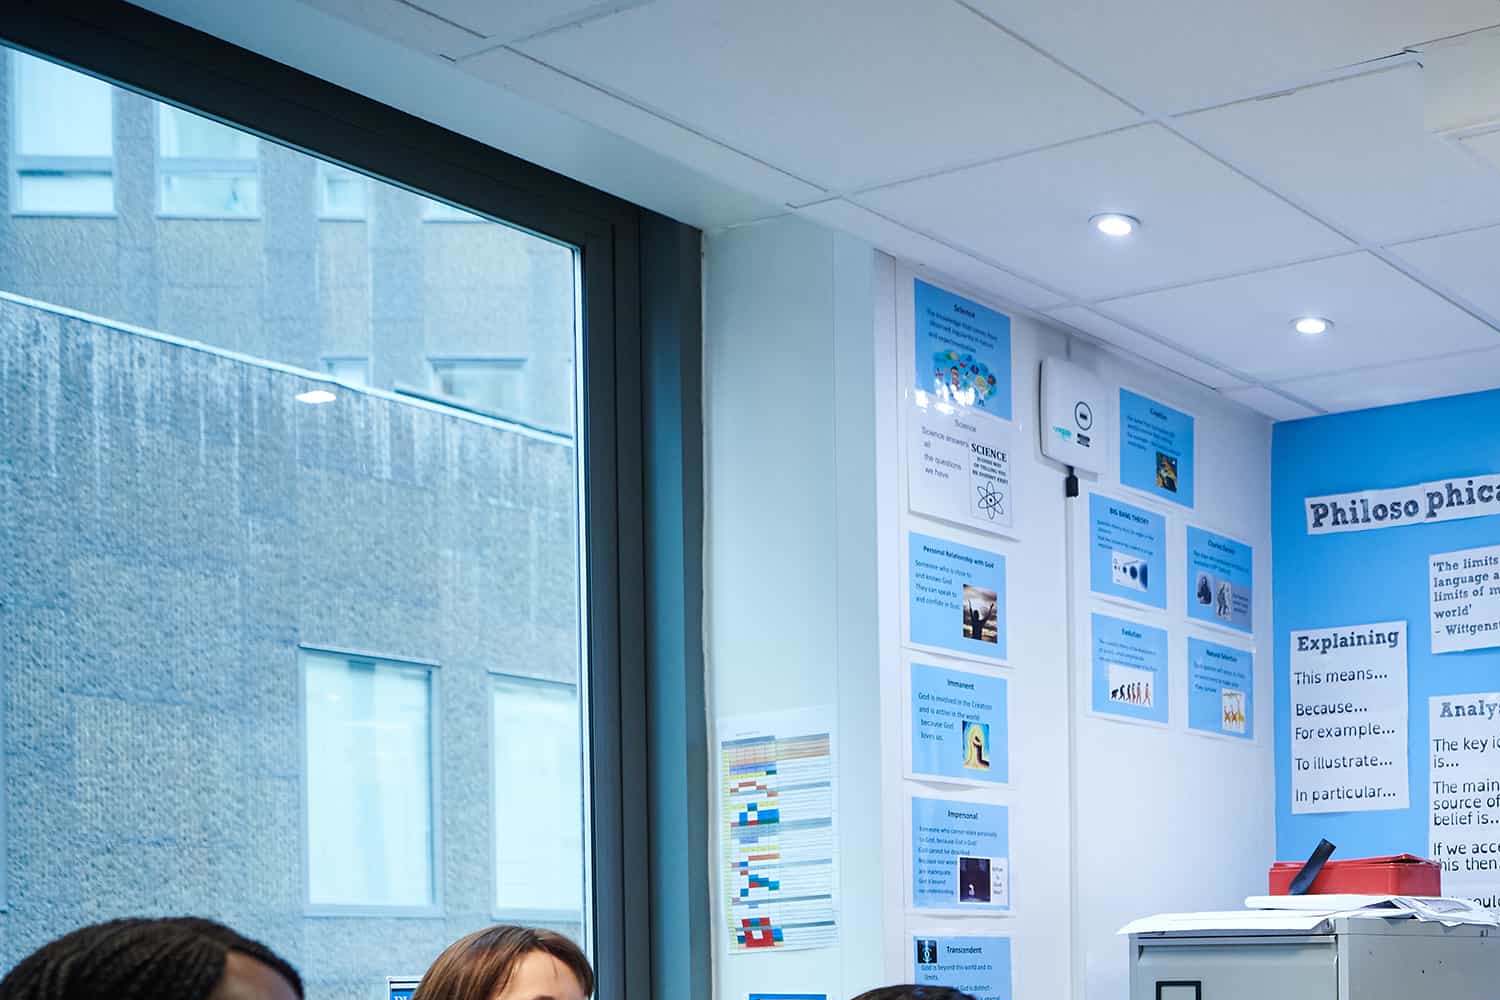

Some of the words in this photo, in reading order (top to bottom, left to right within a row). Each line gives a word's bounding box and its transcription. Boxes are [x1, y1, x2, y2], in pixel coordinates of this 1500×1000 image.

[971, 443, 1007, 463] SCIENCE
[923, 545, 944, 555] Personal
[946, 551, 972, 563] Relationship
[1464, 556, 1498, 568] limits
[1434, 572, 1488, 587] language
[1434, 589, 1468, 602] limits
[1473, 586, 1484, 596] of
[1297, 630, 1399, 653] Explaining
[1295, 672, 1321, 685] This
[1326, 669, 1387, 682] means...
[1296, 702, 1367, 716] Because...
[1296, 727, 1313, 740] For
[1318, 723, 1395, 739] example...
[1434, 739, 1458, 752] The
[1464, 737, 1488, 752] key
[1296, 758, 1309, 771] To
[1314, 756, 1392, 770] illustrate...
[1434, 756, 1459, 768] is...
[1434, 781, 1457, 793] The
[1463, 779, 1500, 792] main
[1296, 789, 1307, 801] In
[1313, 785, 1395, 804] particular...
[1434, 798, 1481, 810] source
[1487, 794, 1500, 807] of
[948, 810, 978, 820] Impersonal
[1434, 812, 1472, 825] belief
[1434, 843, 1442, 856] If
[1446, 844, 1466, 855] we
[1436, 858, 1459, 871] his
